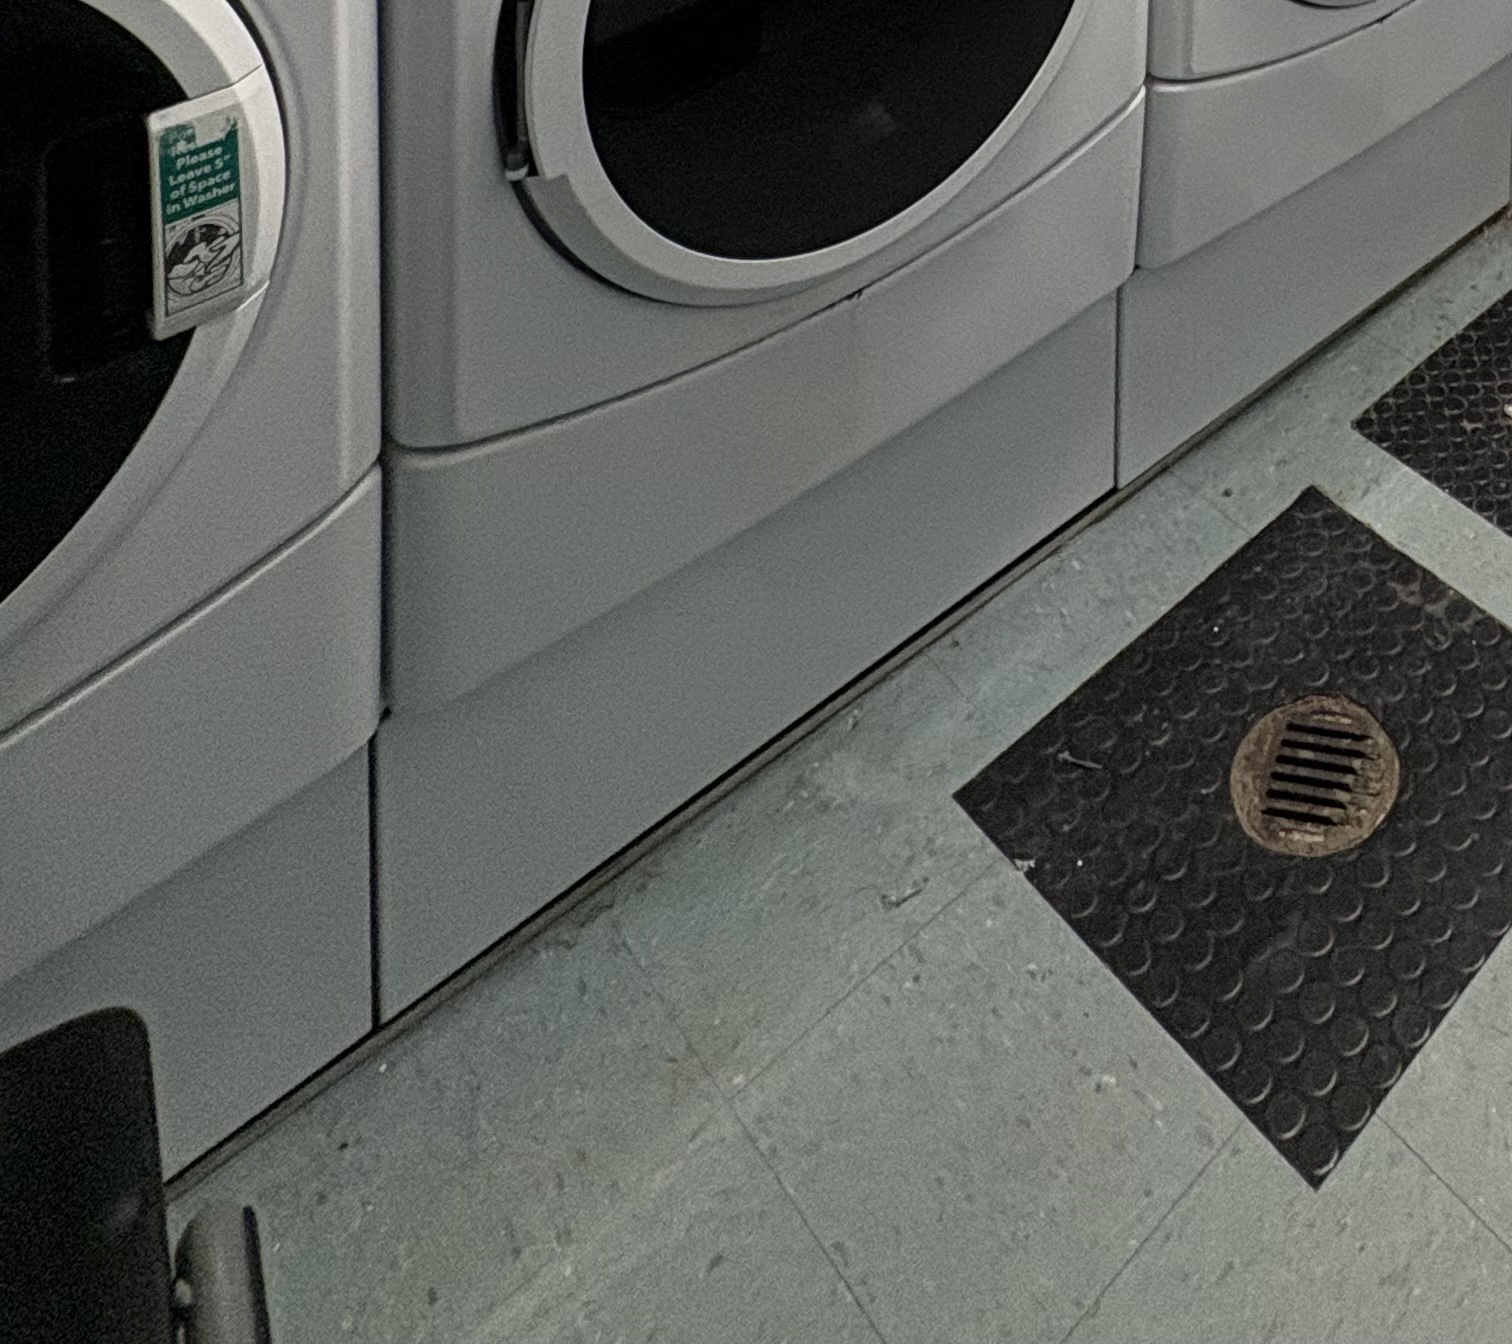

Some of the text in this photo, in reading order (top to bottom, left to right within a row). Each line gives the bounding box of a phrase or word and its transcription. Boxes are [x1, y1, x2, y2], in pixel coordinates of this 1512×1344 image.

[175, 146, 223, 171] Please
[167, 162, 212, 187] Leave
[169, 169, 232, 200] of Space
[165, 182, 237, 215] in Washer
